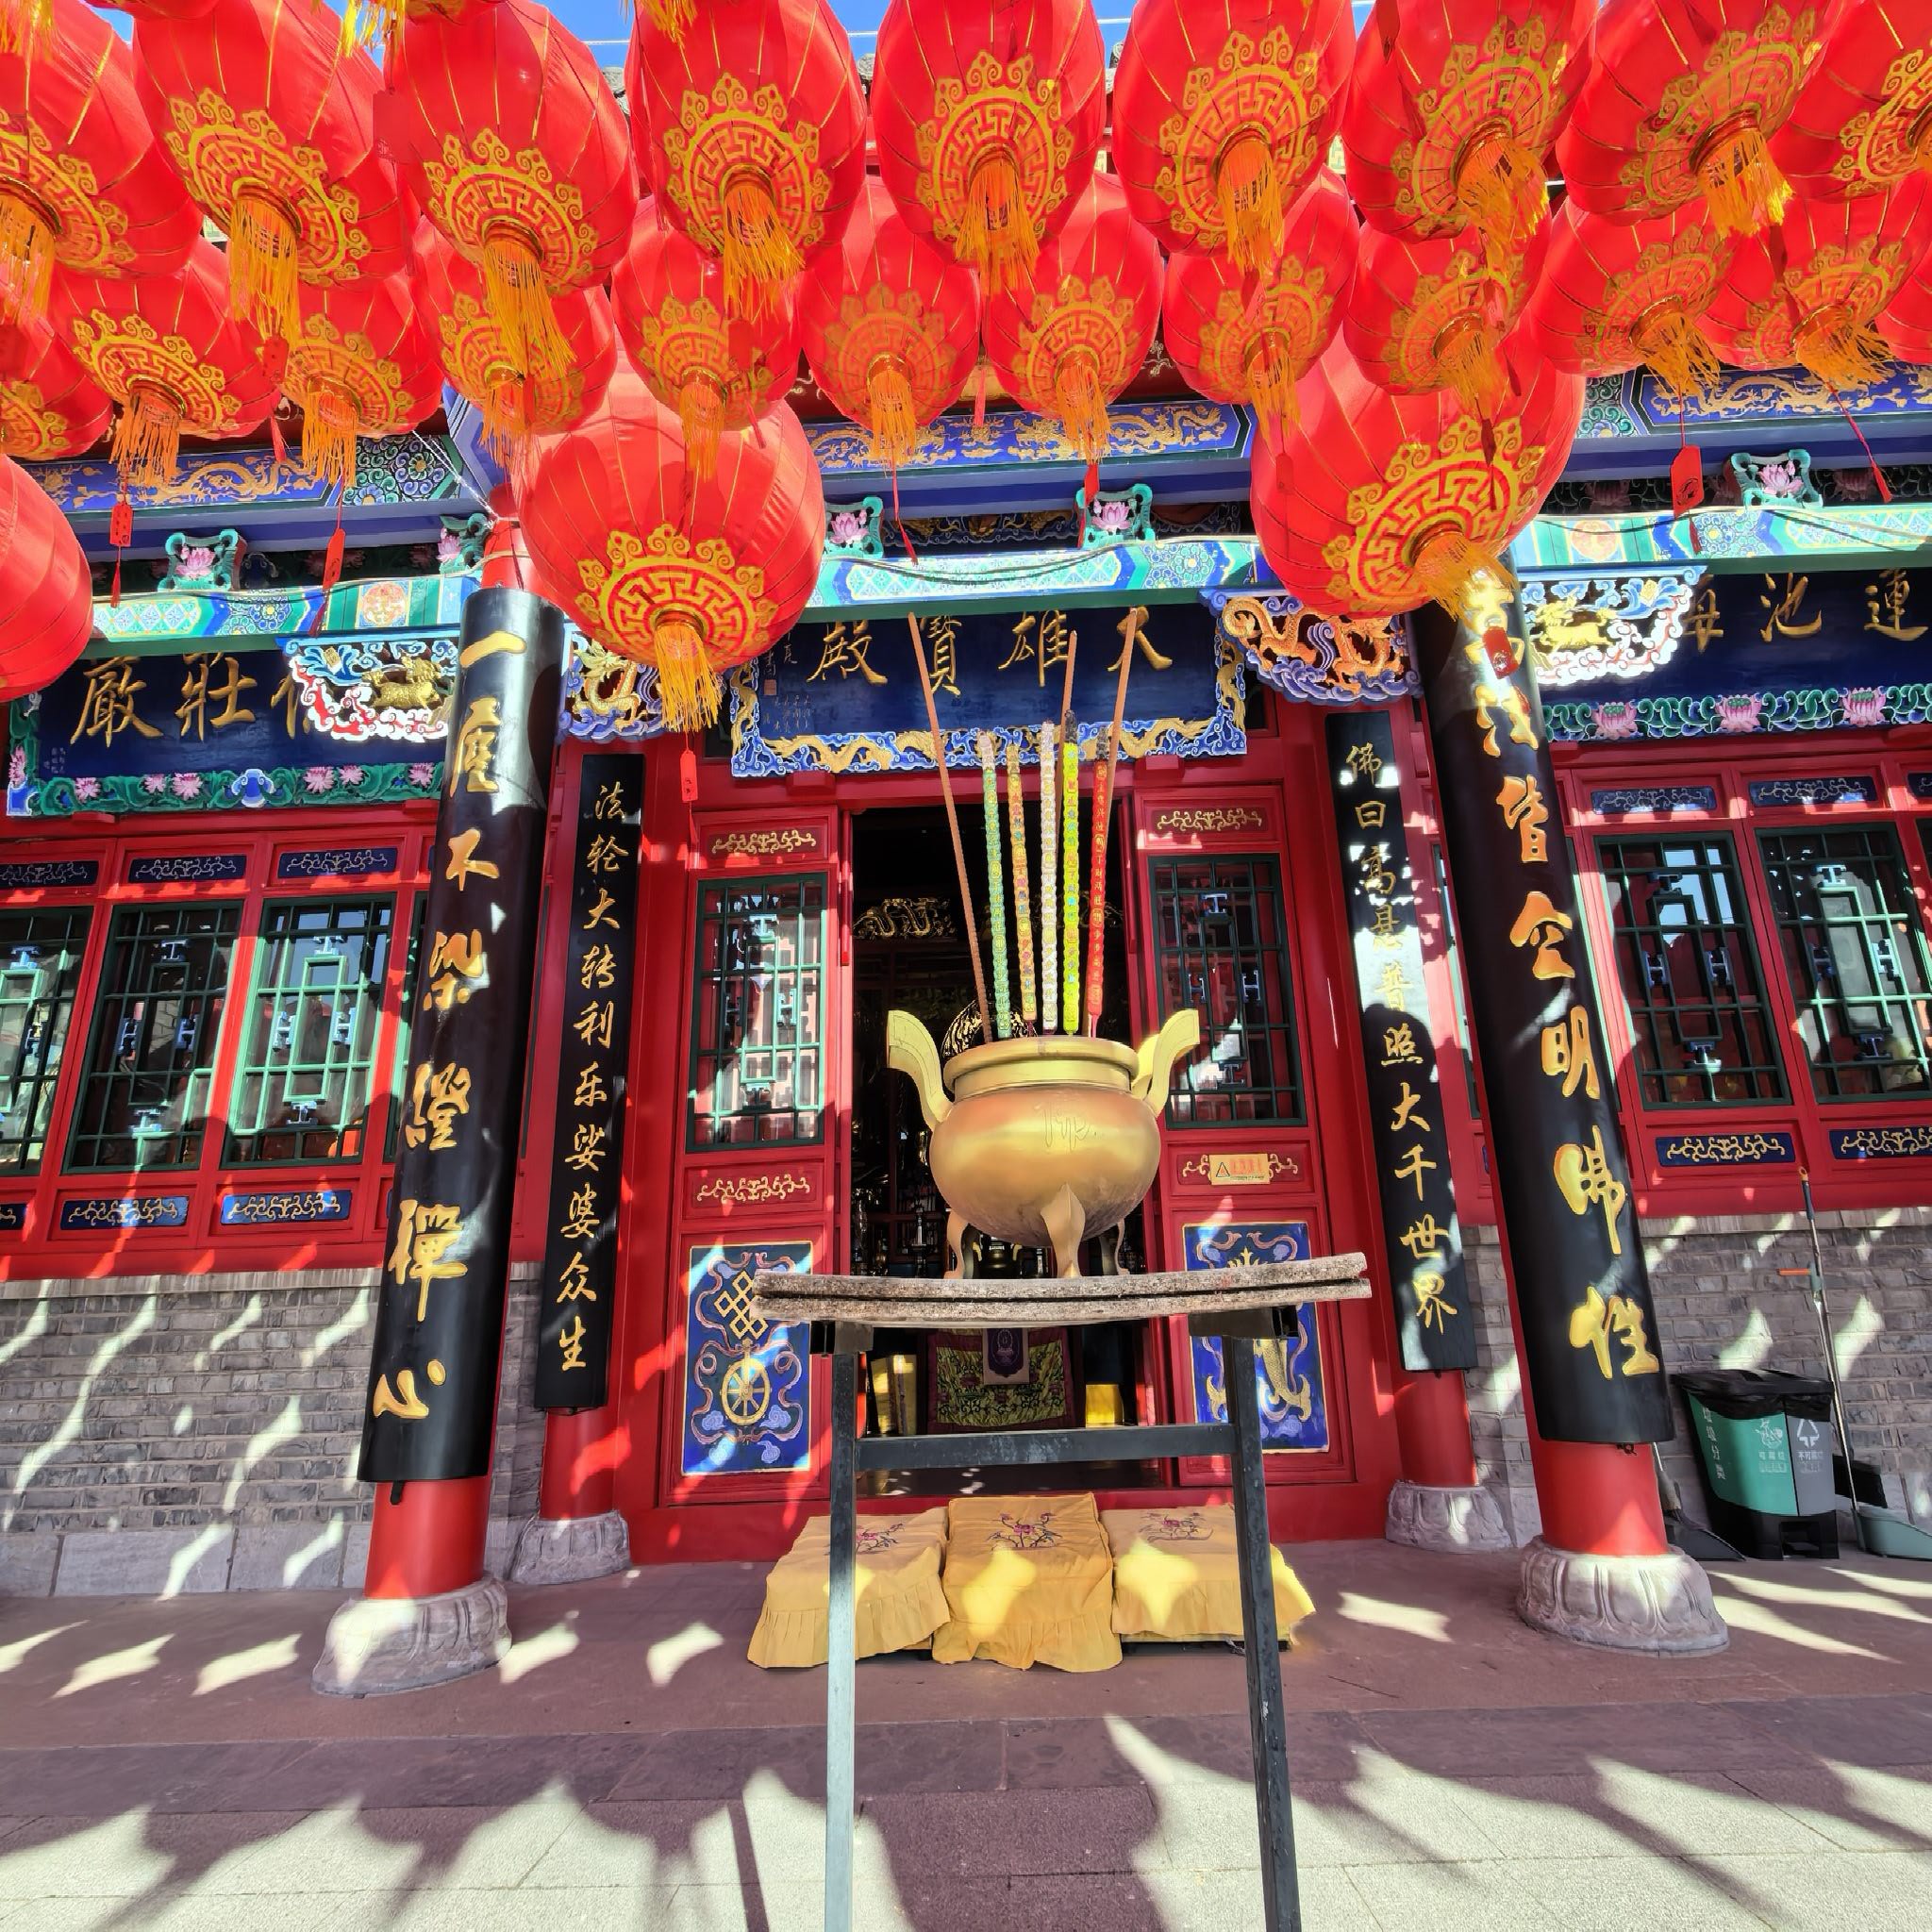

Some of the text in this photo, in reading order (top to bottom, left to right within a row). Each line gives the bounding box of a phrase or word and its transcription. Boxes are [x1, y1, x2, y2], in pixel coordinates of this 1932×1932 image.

[806, 607, 1173, 696] 大雄寶殿
[557, 781, 629, 1372] 法轮大转利乐娑婆众生
